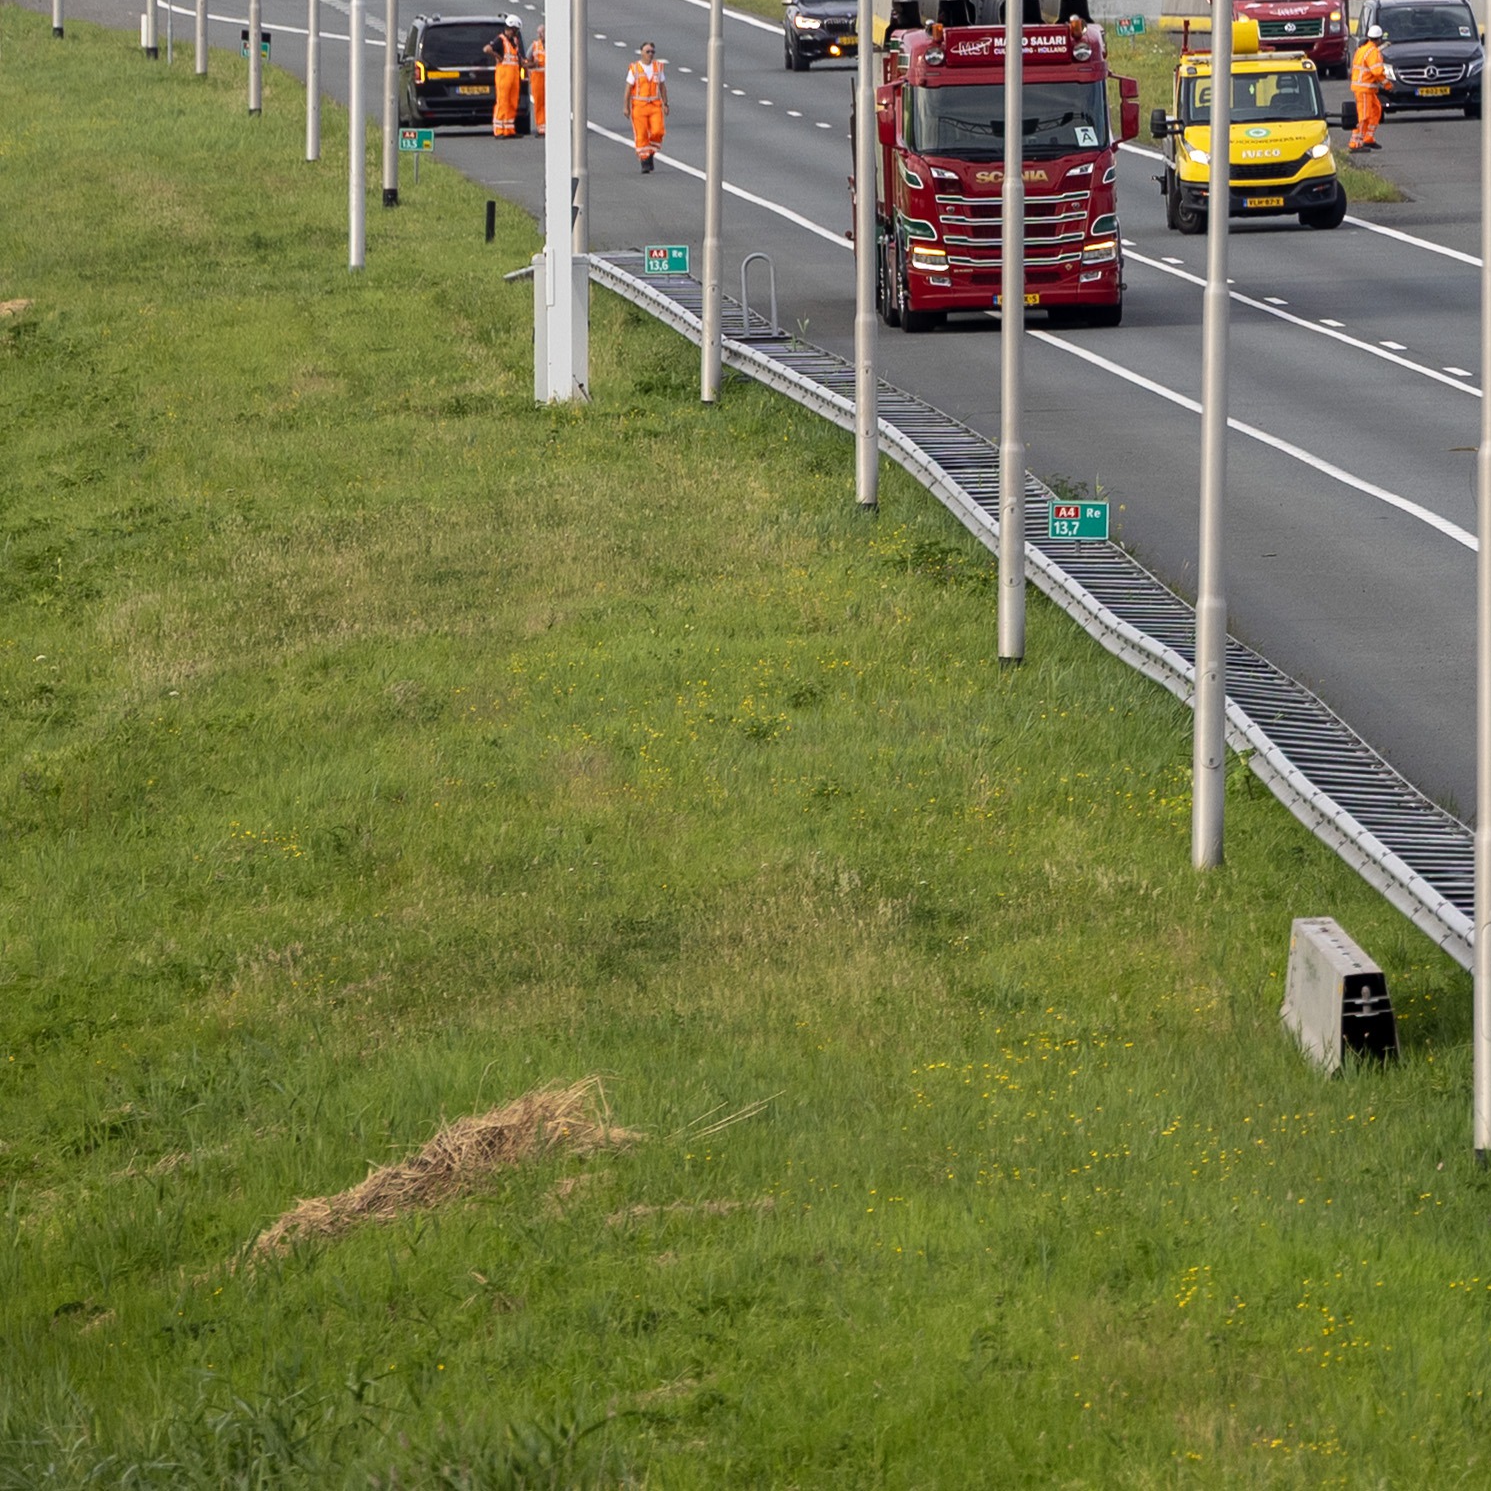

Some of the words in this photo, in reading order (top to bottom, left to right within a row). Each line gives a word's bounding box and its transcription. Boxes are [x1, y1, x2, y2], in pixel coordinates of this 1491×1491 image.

[1030, 35, 1067, 46] SALARI
[1081, 132, 1094, 142] A
[1242, 149, 1281, 159] IVECO
[652, 250, 665, 258] A4
[672, 250, 683, 258] Re
[1058, 507, 1076, 518] A4
[1086, 507, 1102, 519] Re
[1053, 520, 1080, 536] 13,7
